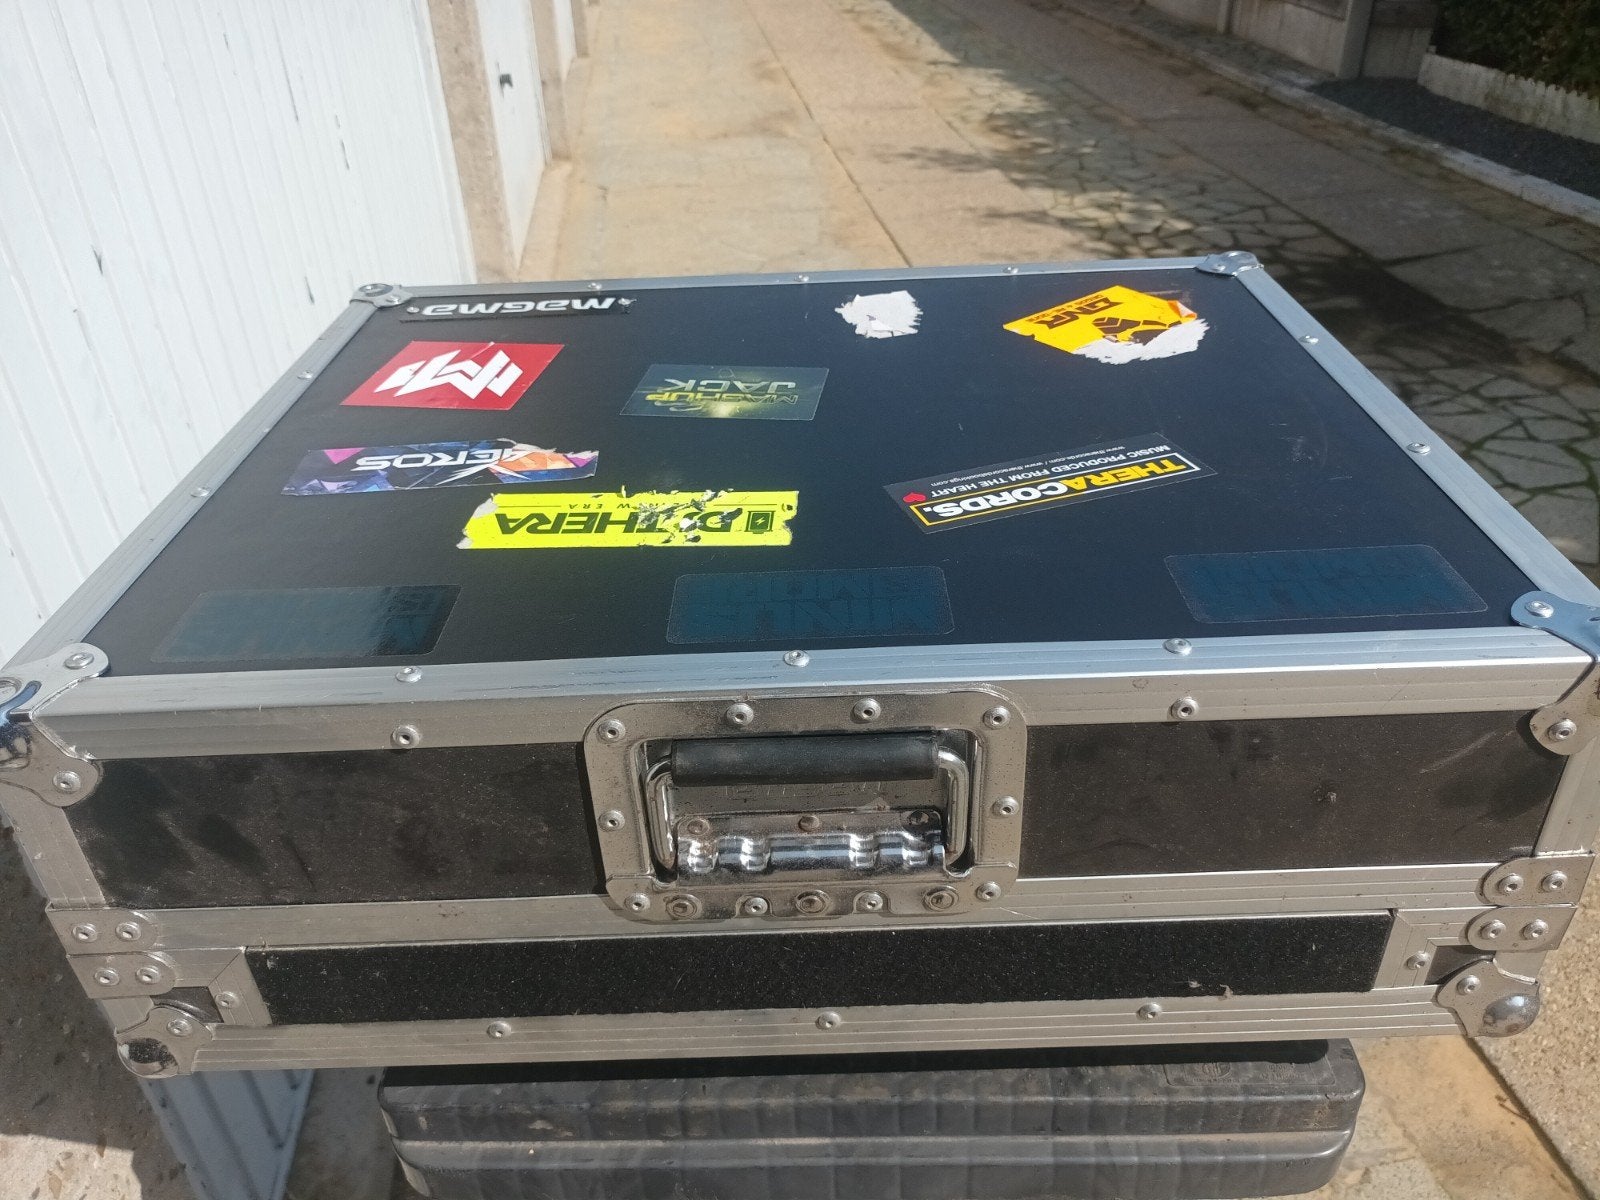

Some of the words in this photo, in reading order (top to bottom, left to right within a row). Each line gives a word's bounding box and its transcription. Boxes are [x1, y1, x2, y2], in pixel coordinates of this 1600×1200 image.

[664, 378, 796, 393] JACK
[645, 392, 799, 405] MASHUP
[1125, 445, 1171, 458] MUSIC
[1051, 453, 1127, 473] PRODUCED
[1008, 468, 1050, 481] FROM
[978, 477, 1008, 488] THE
[931, 483, 978, 498] HEART
[495, 512, 670, 535] THERA
